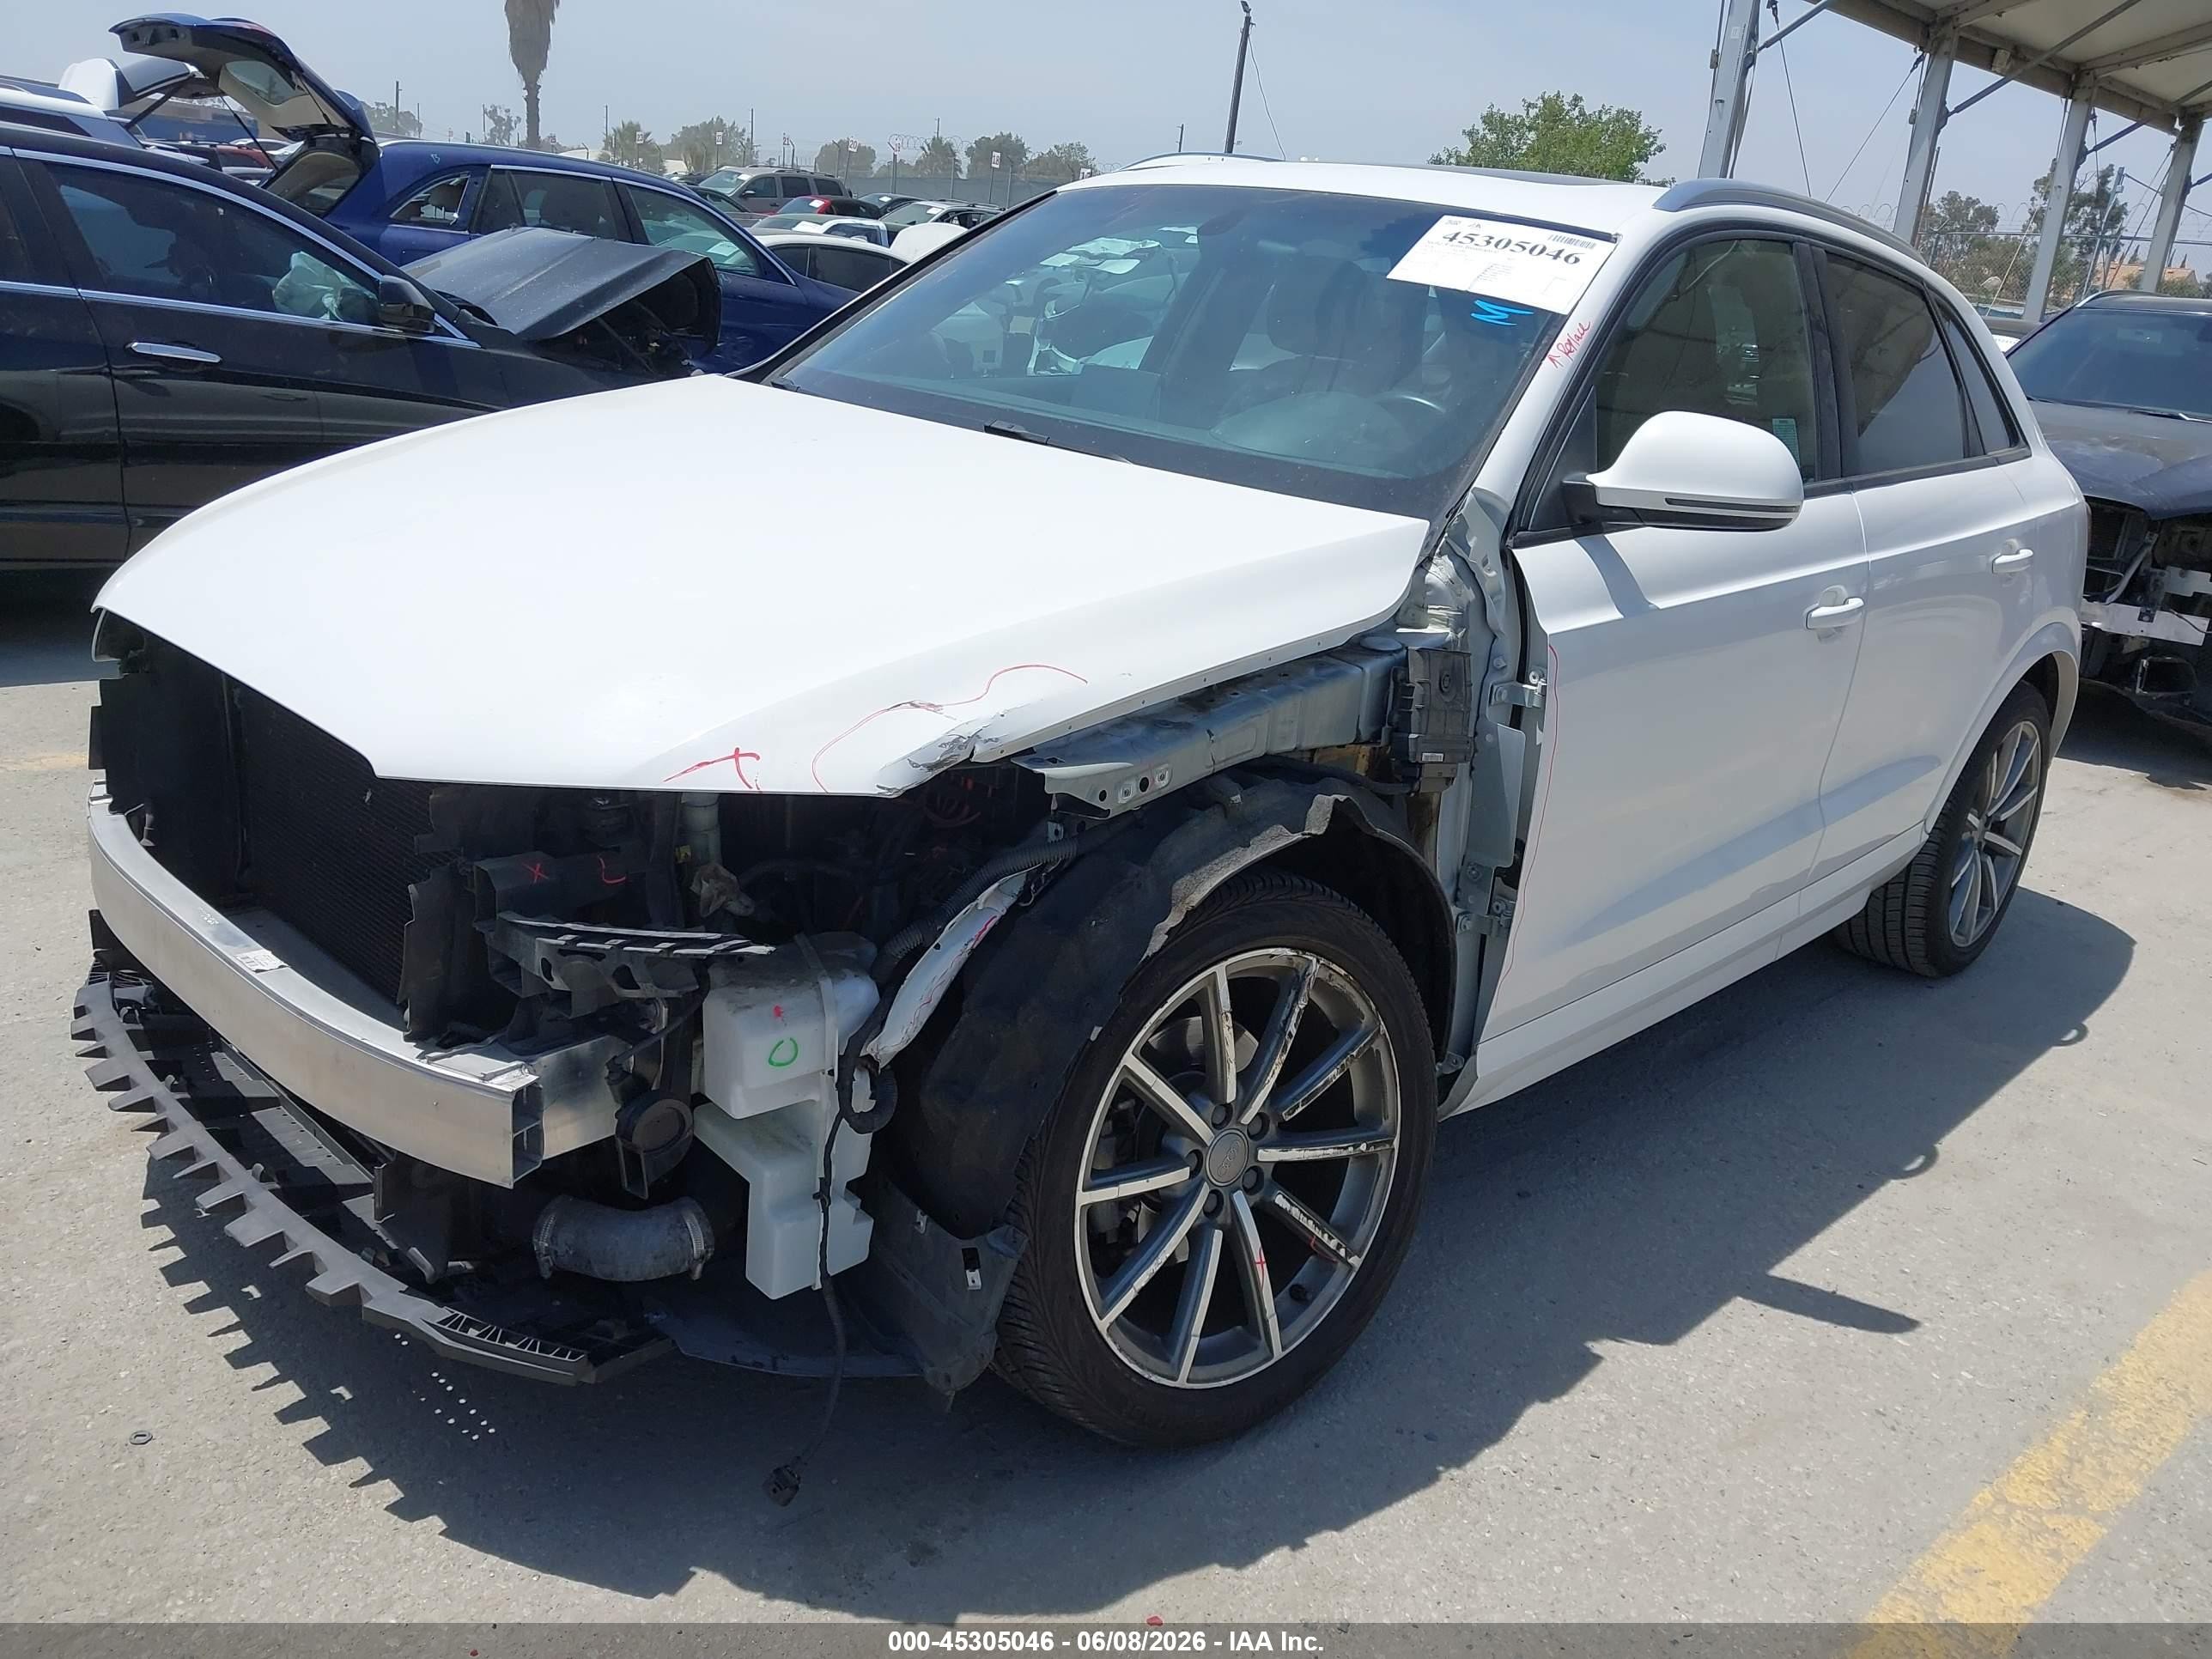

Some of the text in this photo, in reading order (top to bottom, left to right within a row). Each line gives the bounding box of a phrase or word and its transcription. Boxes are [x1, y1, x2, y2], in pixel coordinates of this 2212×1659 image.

[782, 137, 790, 146] 21
[849, 139, 858, 150] 20
[1442, 231, 1586, 265] 45305046
